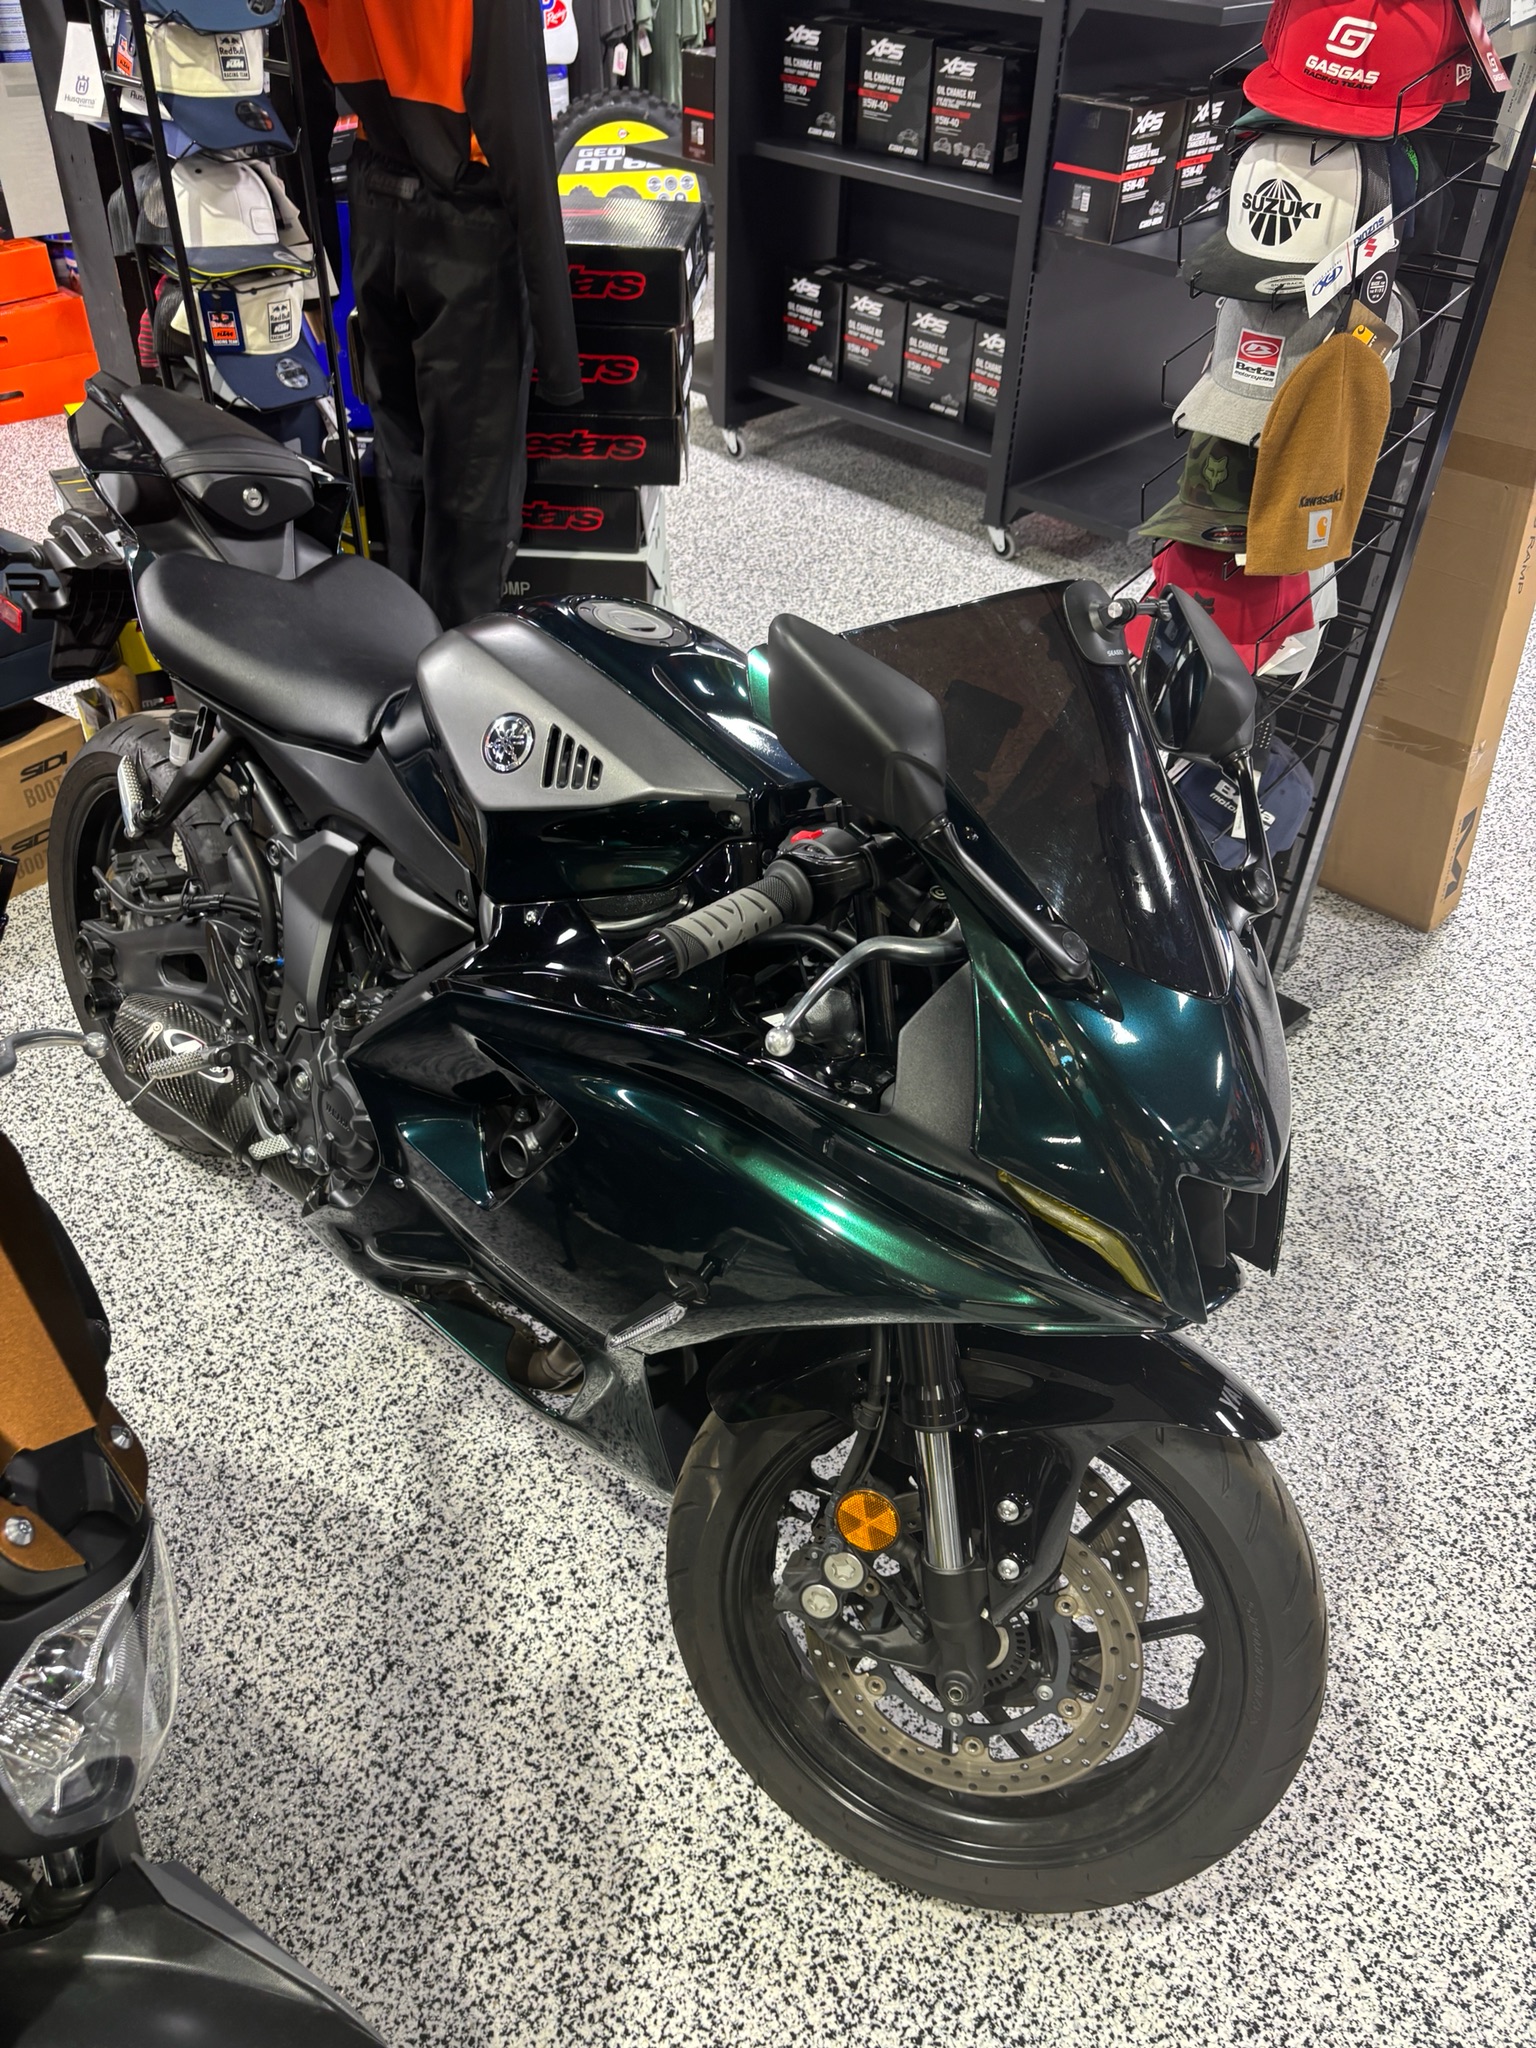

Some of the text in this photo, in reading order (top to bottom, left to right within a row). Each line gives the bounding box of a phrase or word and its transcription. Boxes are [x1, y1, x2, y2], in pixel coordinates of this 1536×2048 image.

[785, 24, 822, 46] XPS
[866, 38, 906, 60] XPS
[939, 56, 978, 77] XPS
[1305, 55, 1380, 84] GASGAS
[1304, 68, 1373, 90] RACING TEAM
[64, 94, 95, 104] Husqvarna
[1131, 110, 1166, 135] XPS
[578, 146, 626, 158] GEO
[1241, 192, 1321, 220] SUZUKI
[1353, 216, 1385, 247] SUZUKI
[789, 278, 821, 298] XPS
[850, 295, 884, 317] XPS
[912, 312, 950, 334] XPS
[978, 333, 1005, 353] XP
[984, 361, 1002, 375] CHANG
[1234, 370, 1274, 382] motorcycles
[1235, 361, 1275, 377] Beta
[1299, 488, 1343, 508] Kawasaki
[1518, 536, 1536, 594] RAMP
[20, 751, 67, 783] SIDI
[11, 828, 50, 856] SID
[17, 851, 48, 879] BOO
